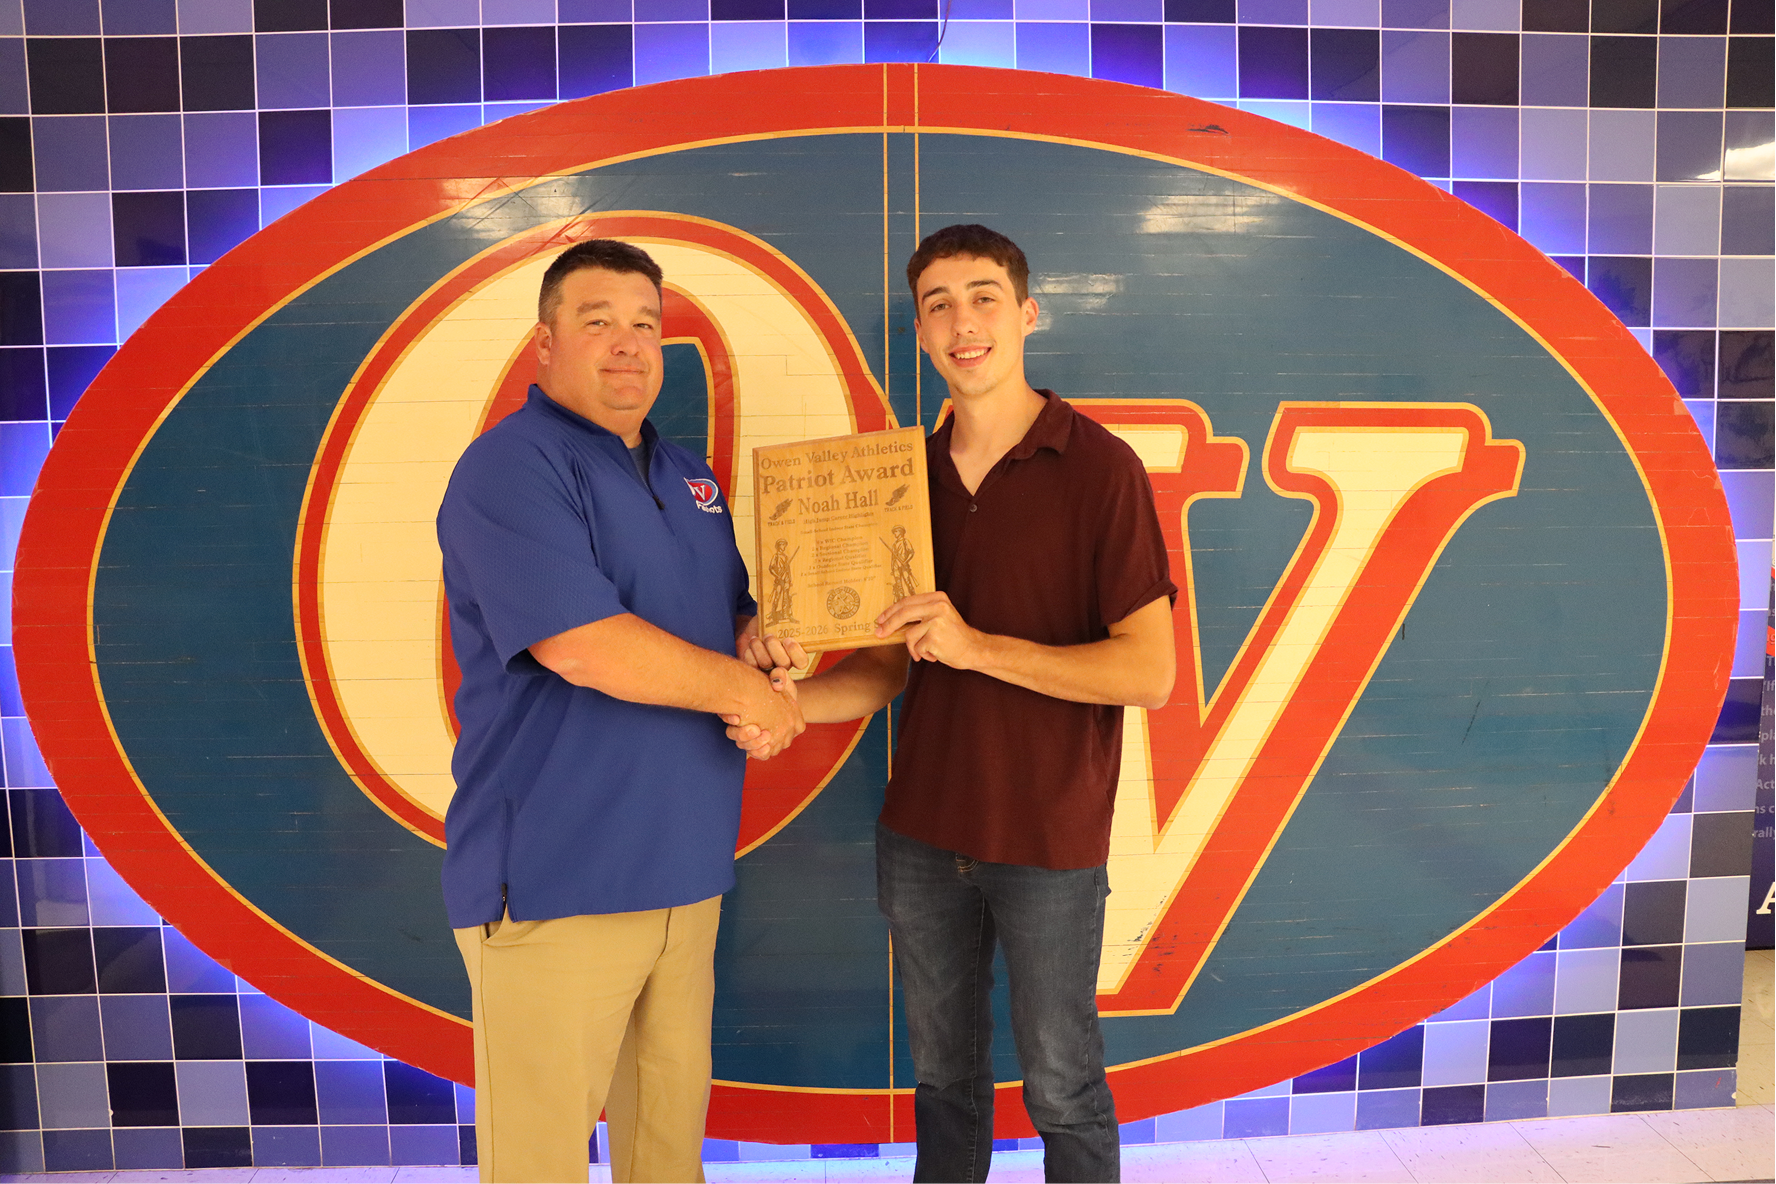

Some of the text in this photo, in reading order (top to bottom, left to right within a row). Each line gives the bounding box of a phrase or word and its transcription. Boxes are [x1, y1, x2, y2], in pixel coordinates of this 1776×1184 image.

[760, 440, 914, 470] Owen Valley Athletics
[762, 457, 915, 495] Patriot Award
[798, 489, 879, 516] Noah Hall
[778, 624, 828, 639] 2025-2026
[834, 622, 871, 635] Spring
[1761, 705, 1775, 716] th
